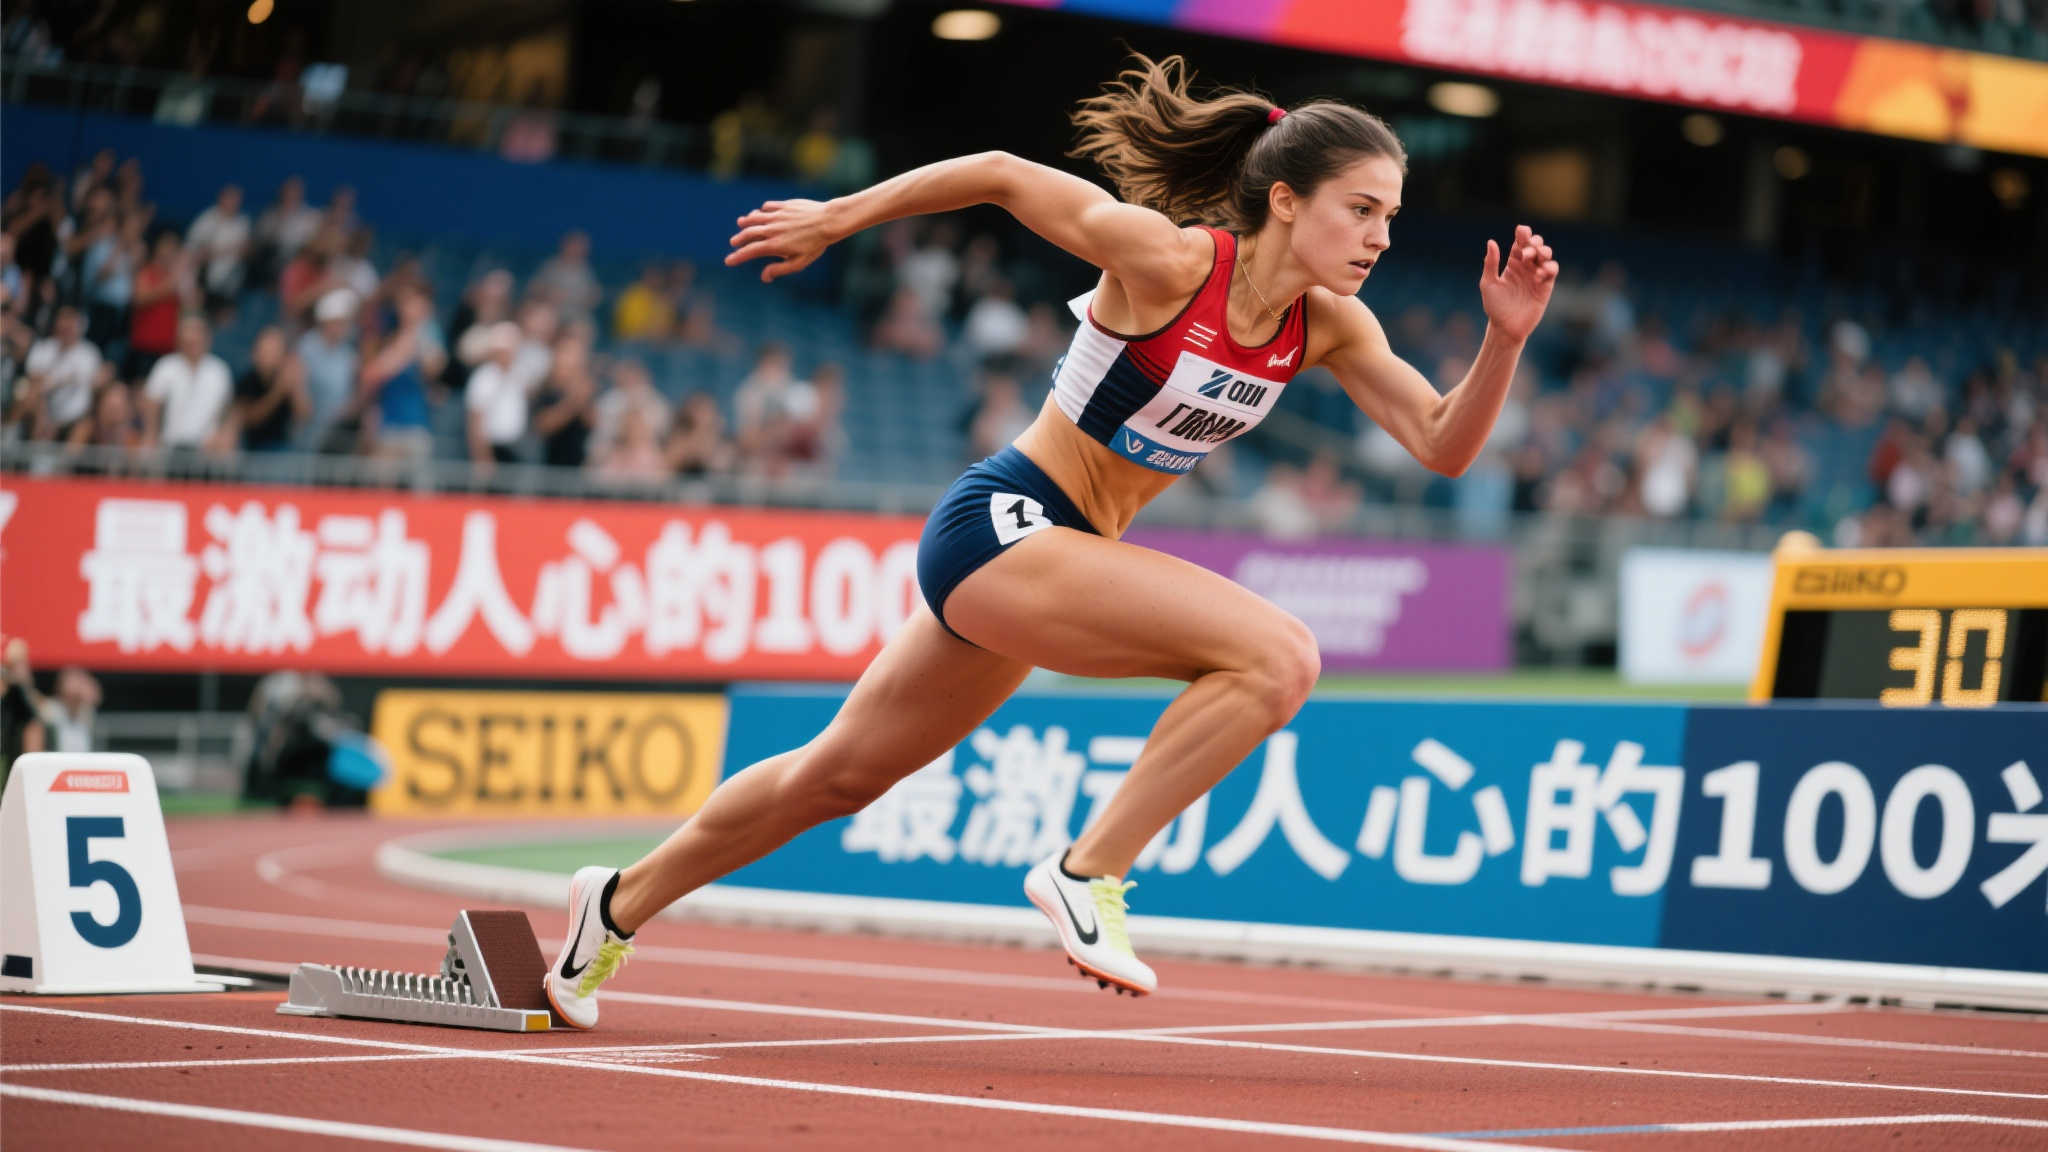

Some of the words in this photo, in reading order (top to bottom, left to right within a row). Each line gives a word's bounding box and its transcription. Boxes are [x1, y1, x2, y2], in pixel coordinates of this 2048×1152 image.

[1006, 498, 1034, 530] 1
[1880, 609, 2008, 708] 30
[404, 709, 695, 806] SEIKO
[66, 816, 143, 949] 5
